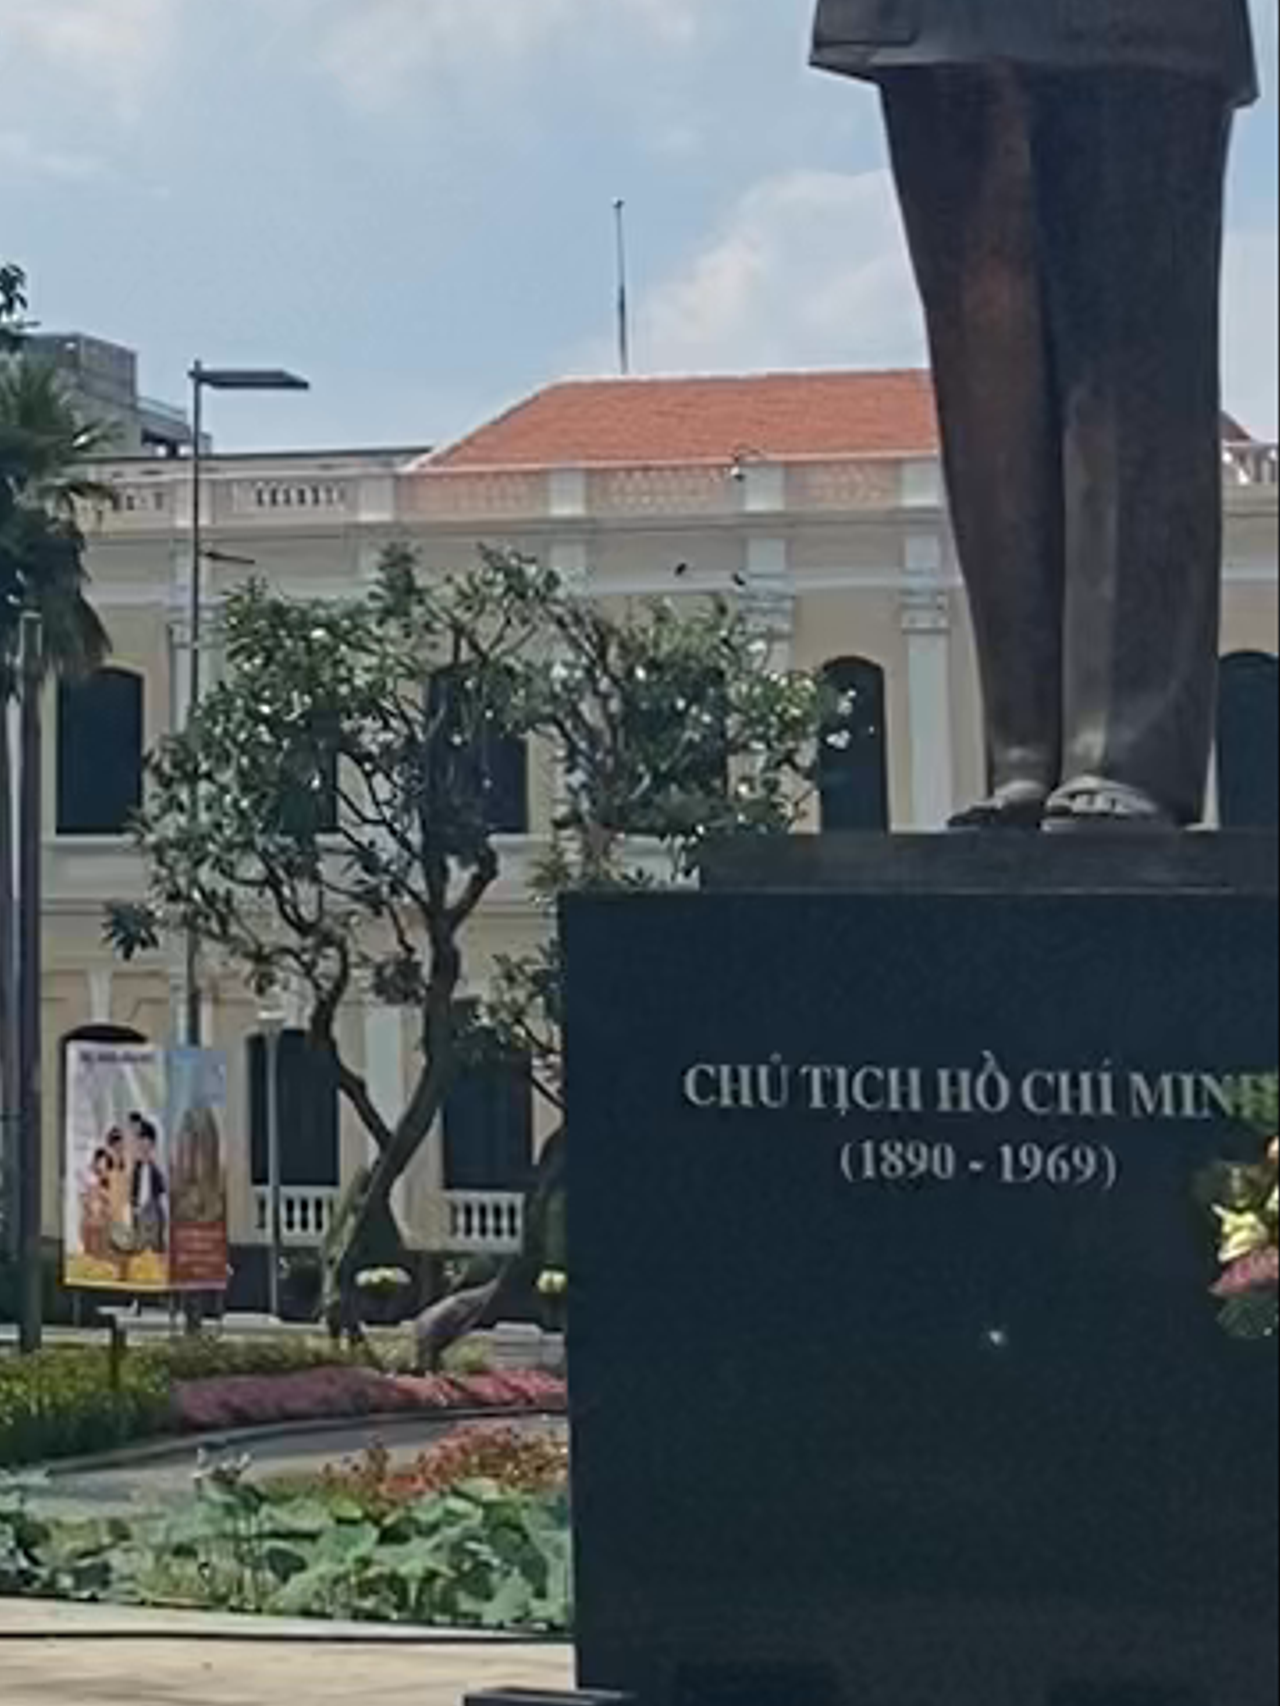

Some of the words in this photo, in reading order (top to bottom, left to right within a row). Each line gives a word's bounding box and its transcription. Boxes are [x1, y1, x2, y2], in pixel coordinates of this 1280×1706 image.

[683, 1052, 790, 1109] CHỦ
[798, 1064, 924, 1116] TỊCH
[936, 1049, 1011, 1113] HỒ
[1021, 1056, 1116, 1116] CHÍ
[840, 1139, 956, 1183] (1890
[968, 1159, 985, 1172] -
[999, 1141, 1117, 1190] 1969)
